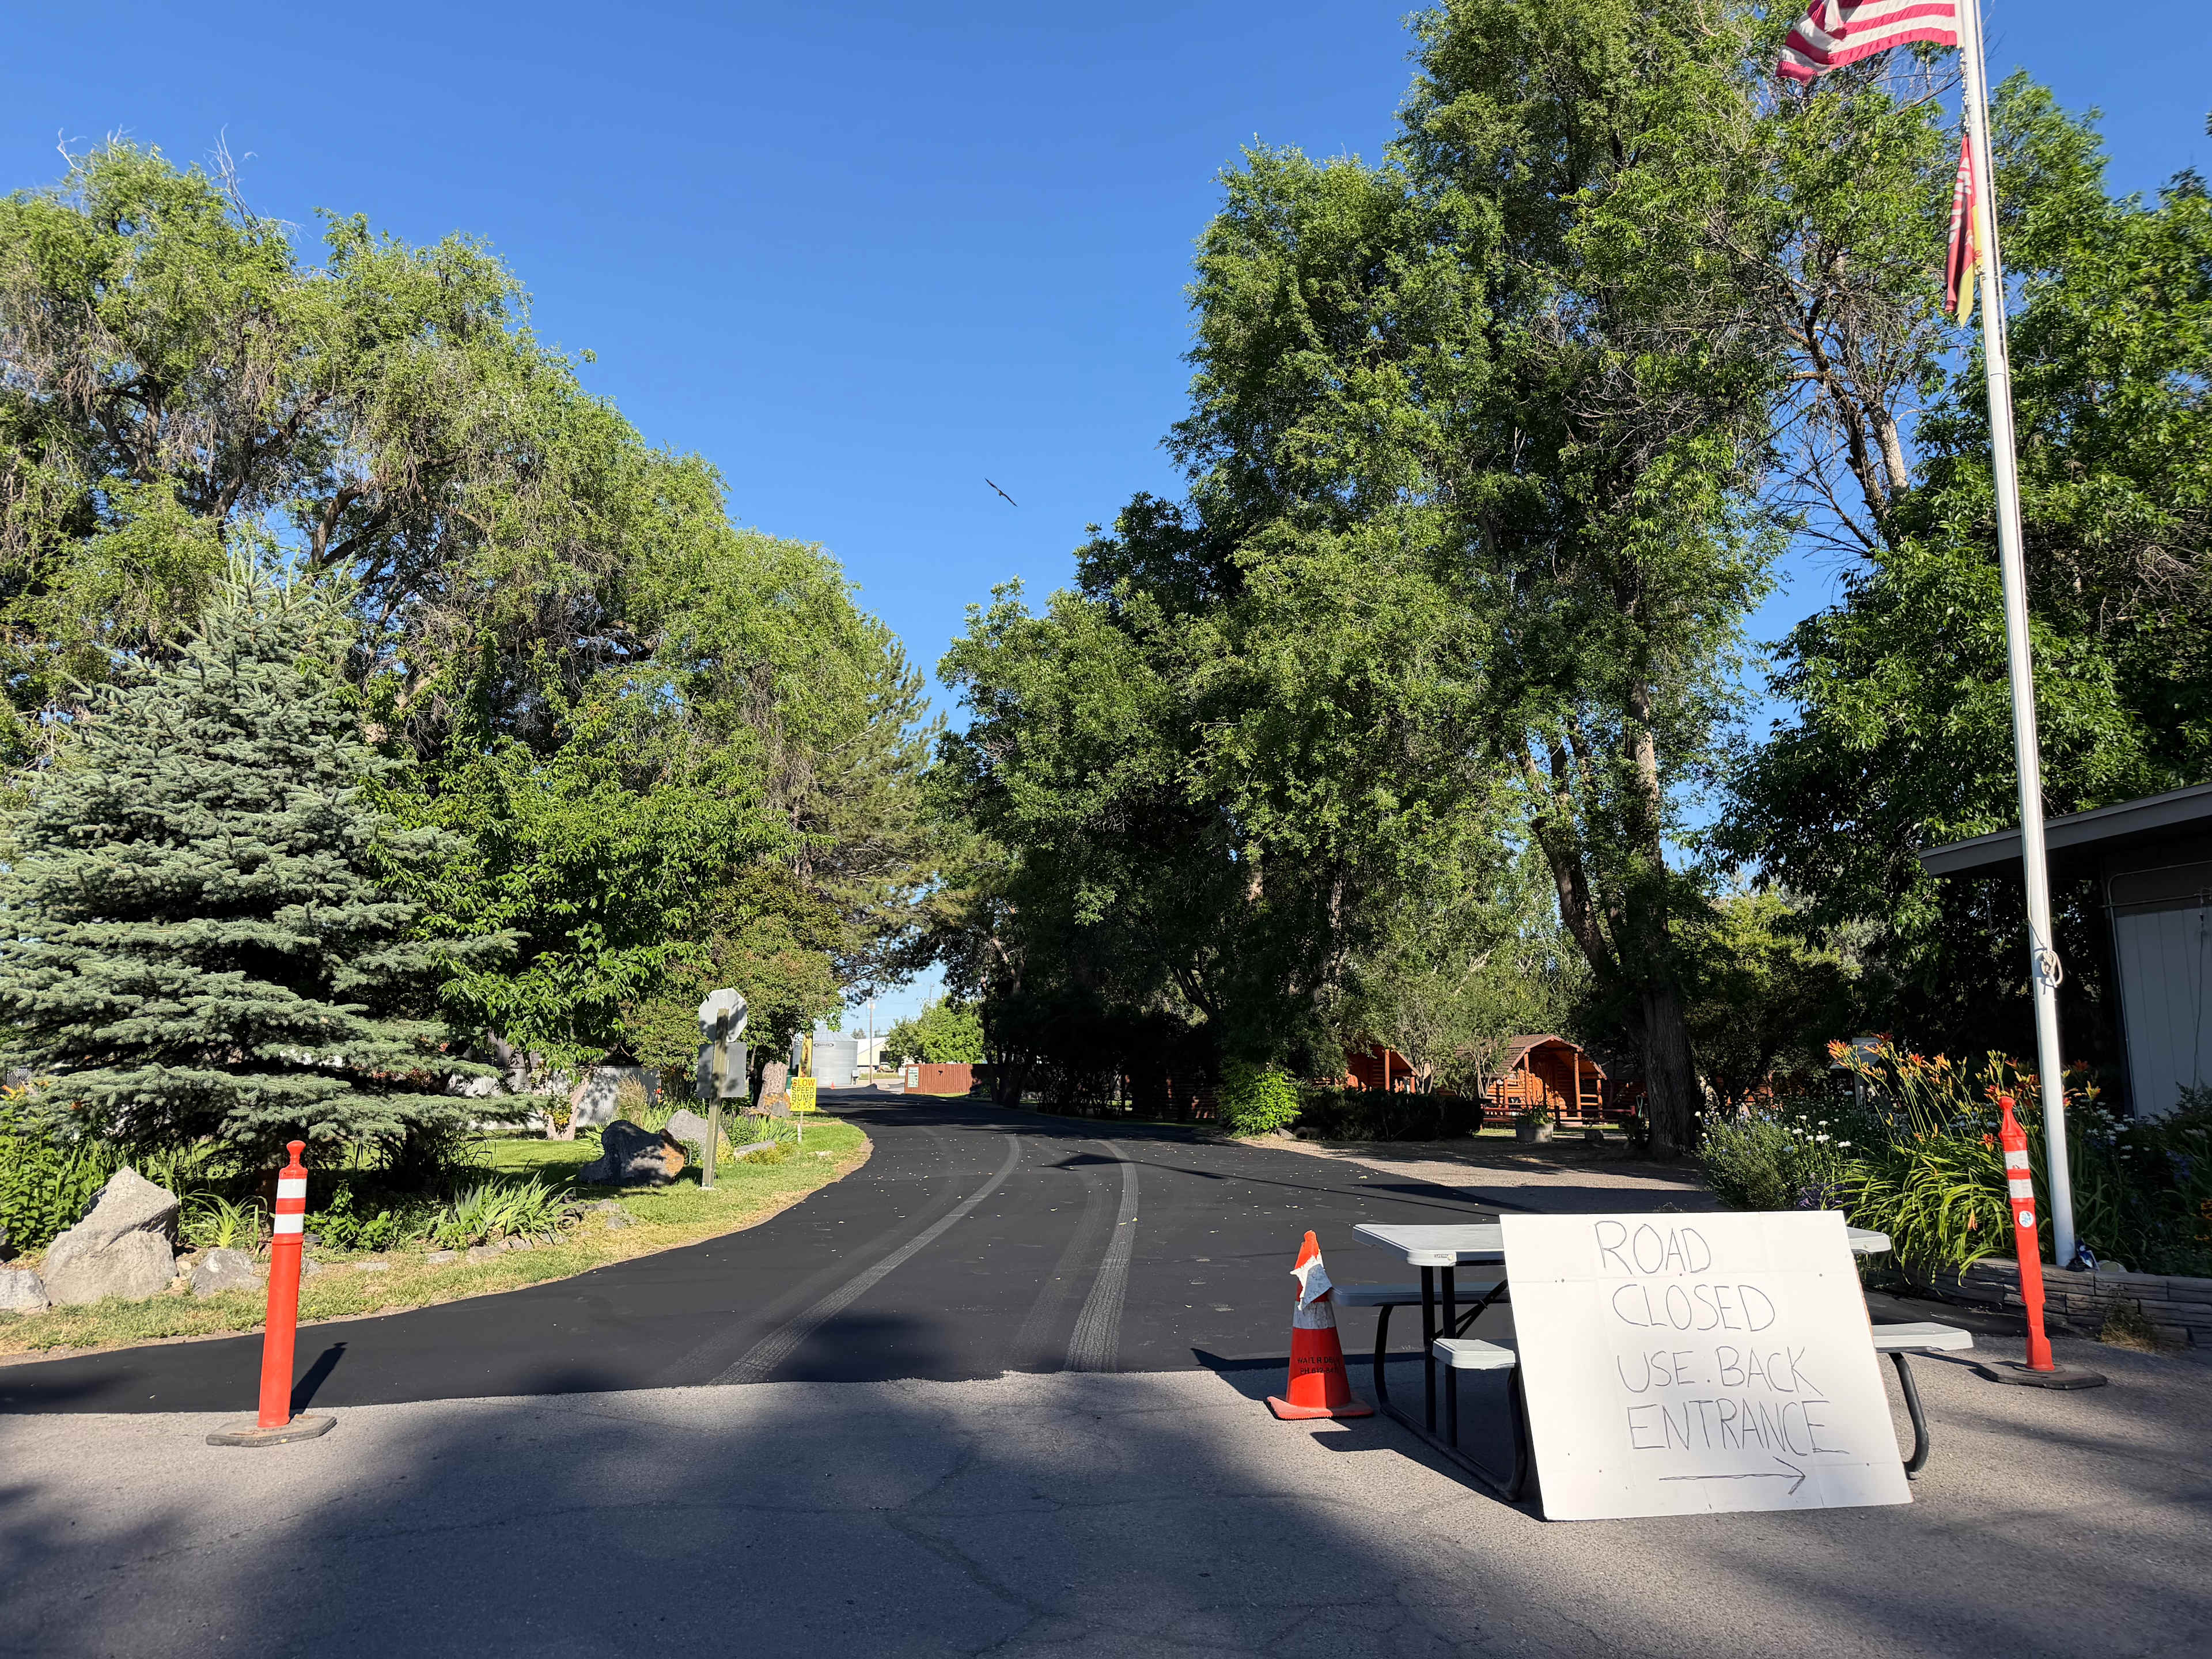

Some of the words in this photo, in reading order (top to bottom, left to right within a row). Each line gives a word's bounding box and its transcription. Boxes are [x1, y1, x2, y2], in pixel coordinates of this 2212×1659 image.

[793, 1079, 815, 1087] SLOW
[1594, 1220, 1711, 1275] ROAD
[1612, 1284, 1775, 1332] CLOSED
[1297, 1356, 1322, 1365] WATER
[1617, 1350, 1695, 1393] USE
[1716, 1346, 1824, 1396] BACK
[1627, 1398, 1850, 1456] ENTRANCE
